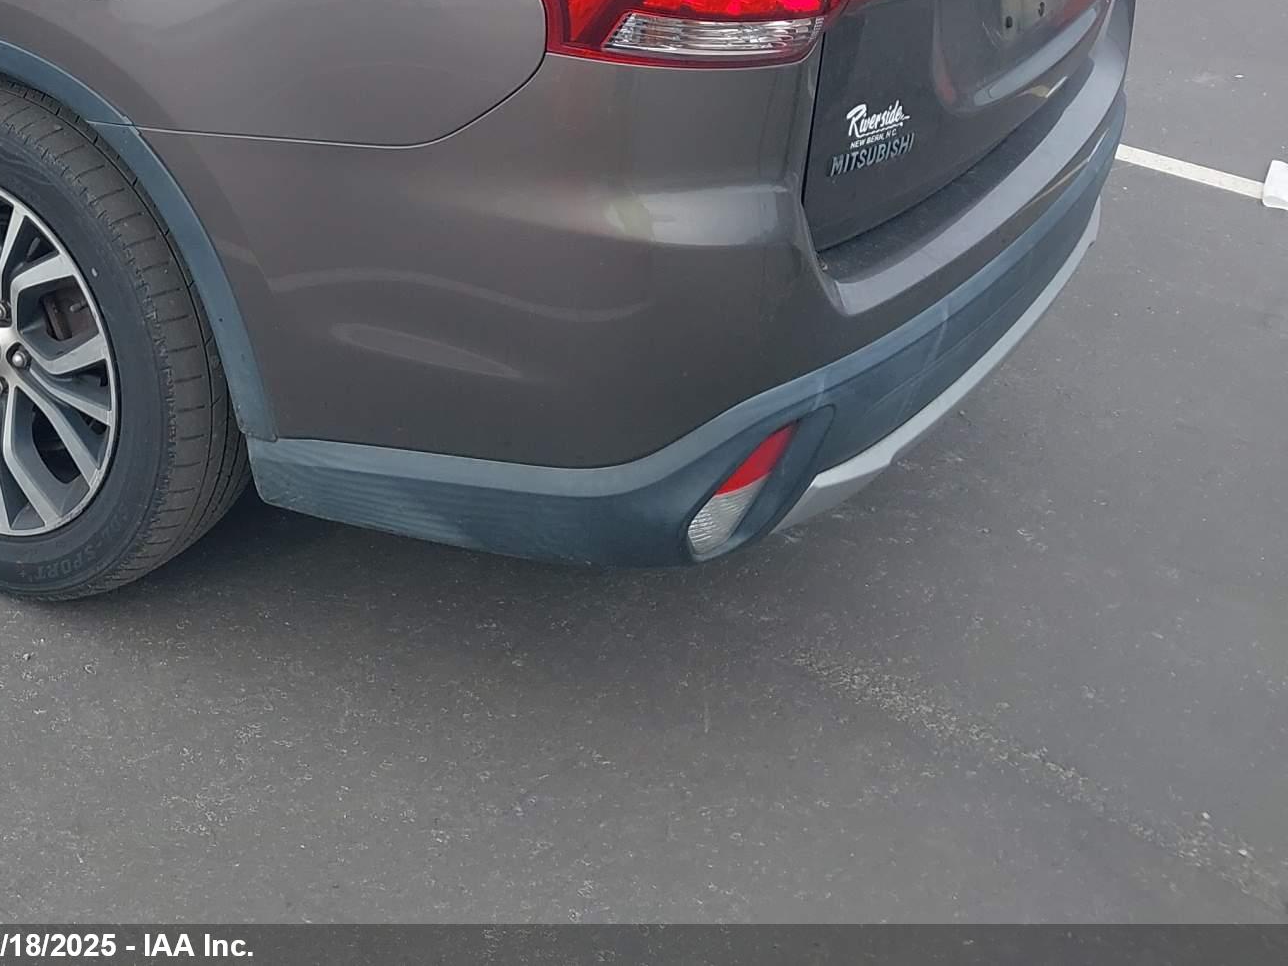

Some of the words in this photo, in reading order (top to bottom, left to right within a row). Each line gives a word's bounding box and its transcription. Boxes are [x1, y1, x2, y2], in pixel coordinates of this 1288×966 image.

[846, 99, 910, 138] Riverside
[829, 132, 915, 177] MITSUBISHI
[850, 137, 866, 149] NEW
